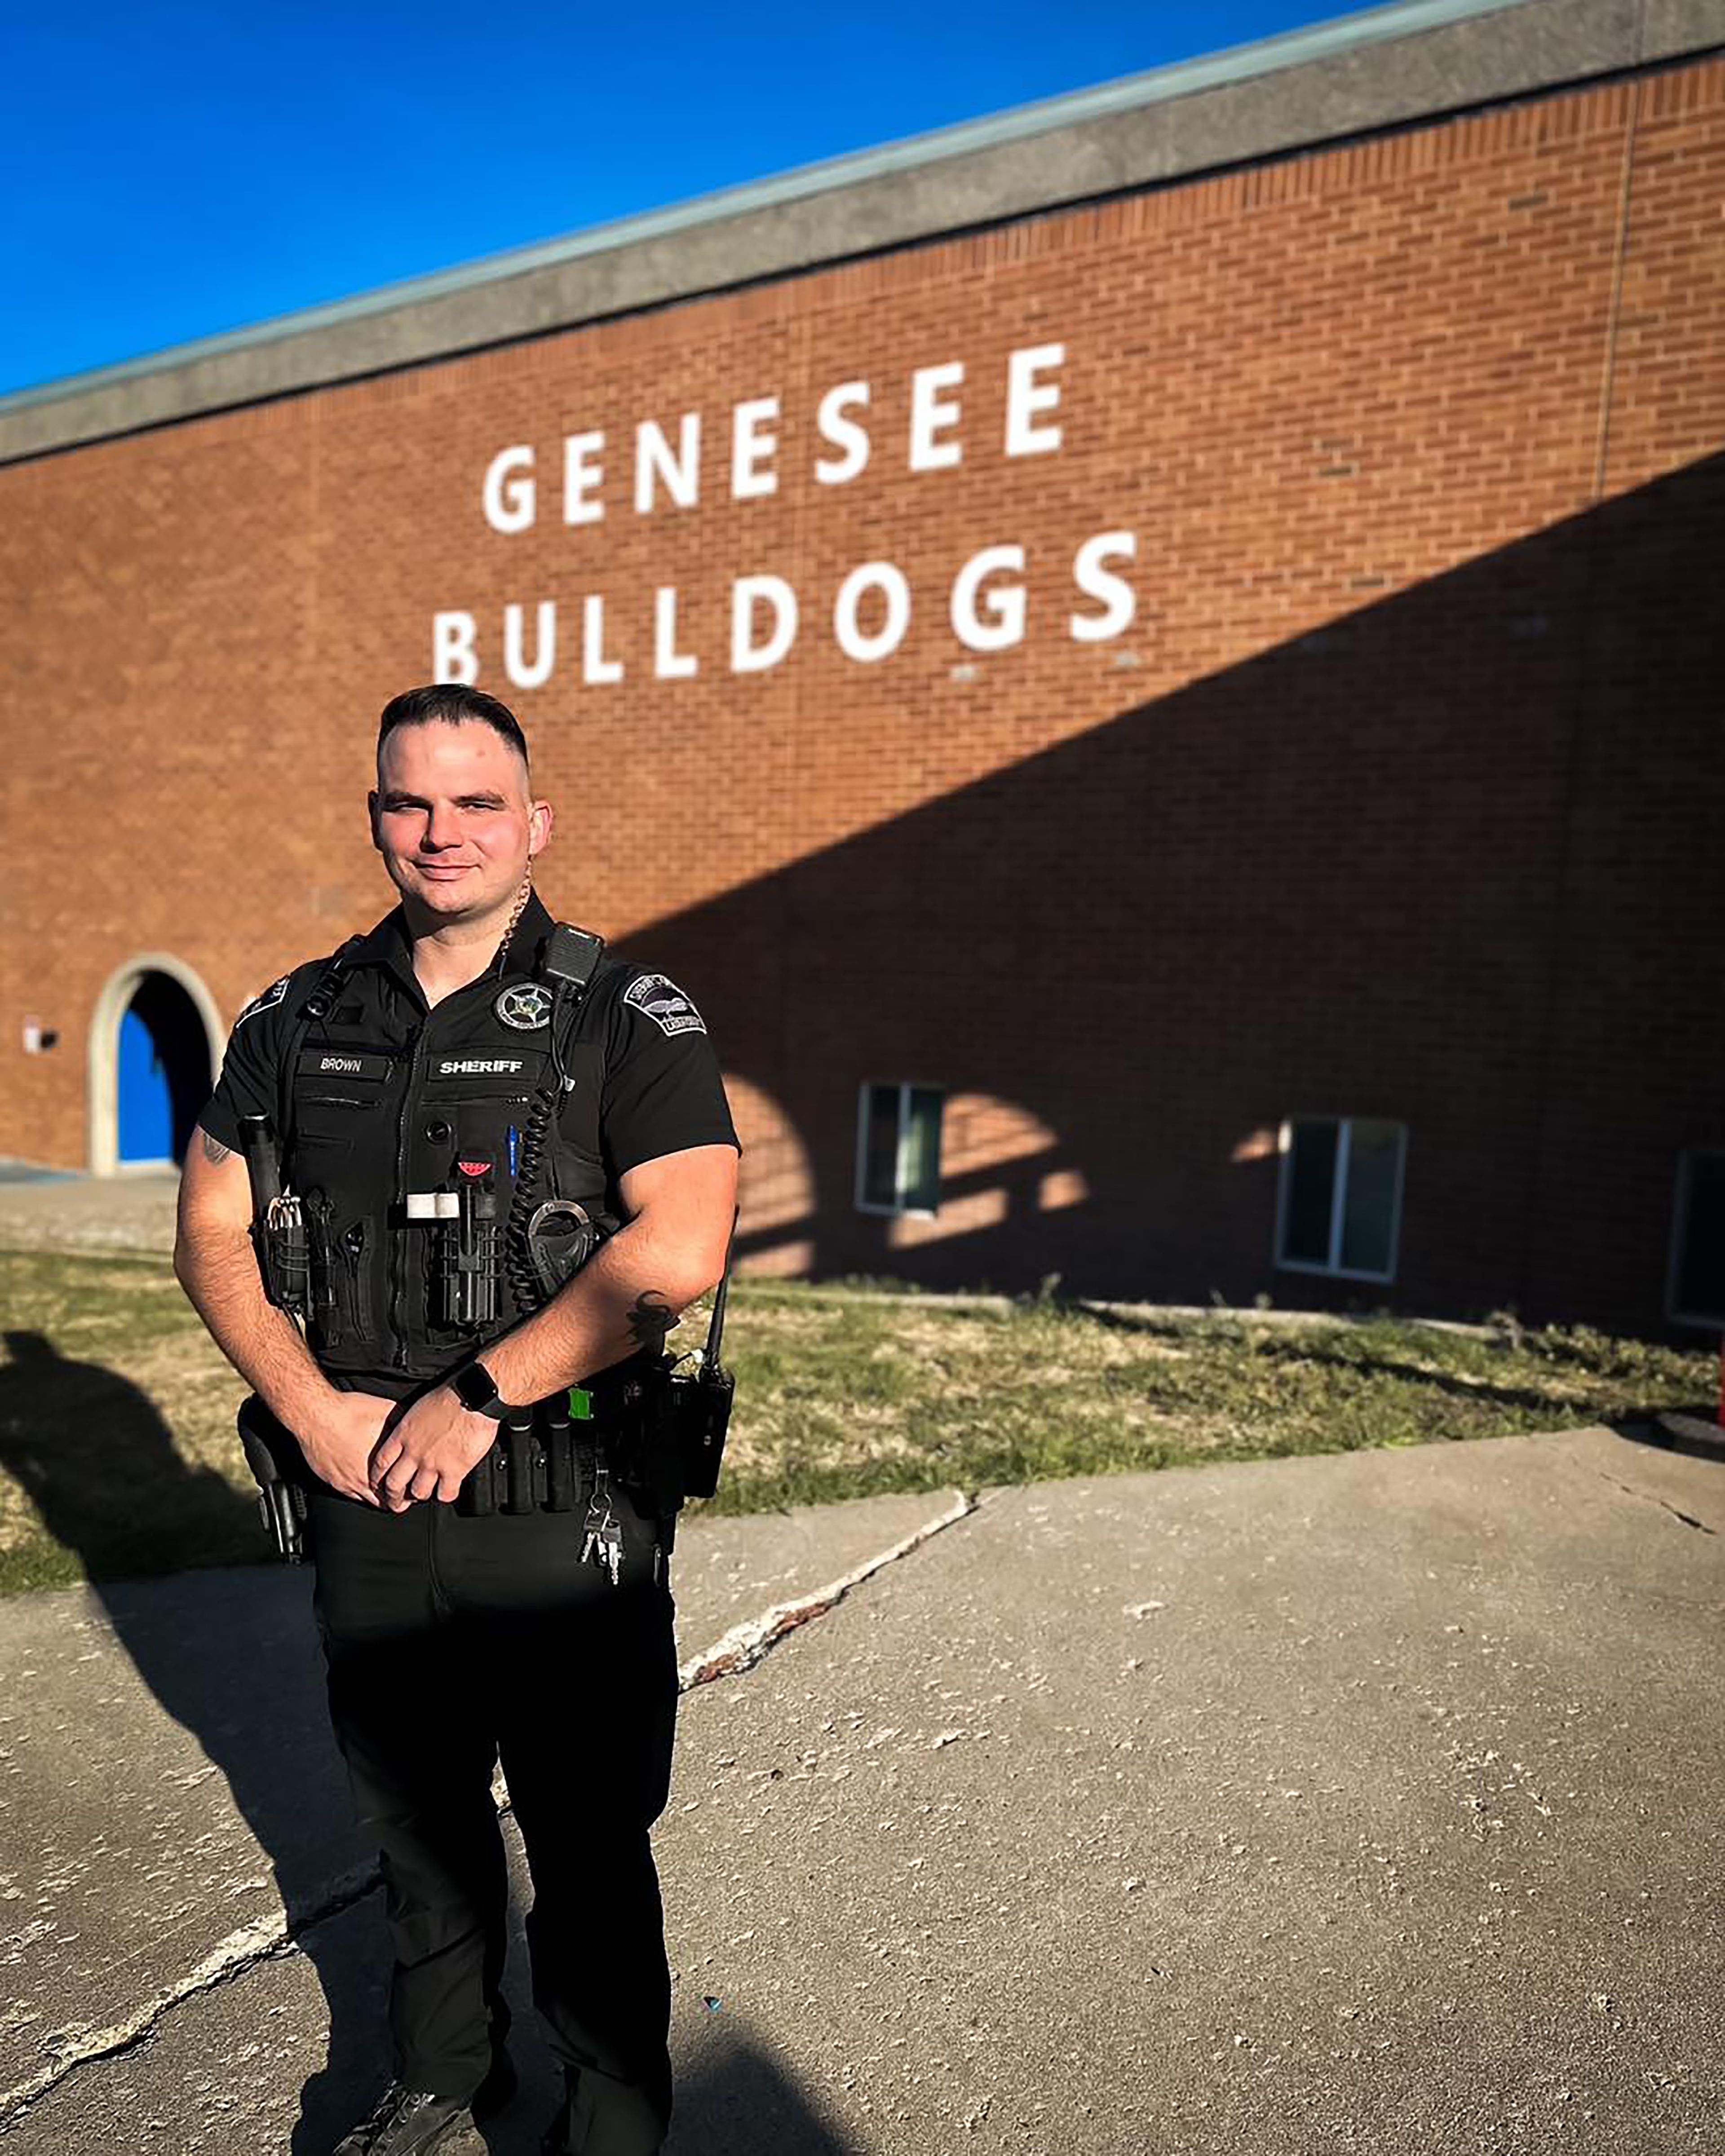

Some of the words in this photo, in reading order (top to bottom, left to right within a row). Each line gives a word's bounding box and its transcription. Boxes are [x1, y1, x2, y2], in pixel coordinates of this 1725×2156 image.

[482, 343, 1065, 533] GENESEE
[433, 530, 1137, 689] BULLDOGS
[320, 1057, 362, 1073] BROWN
[439, 1060, 523, 1074] SHERIFF
